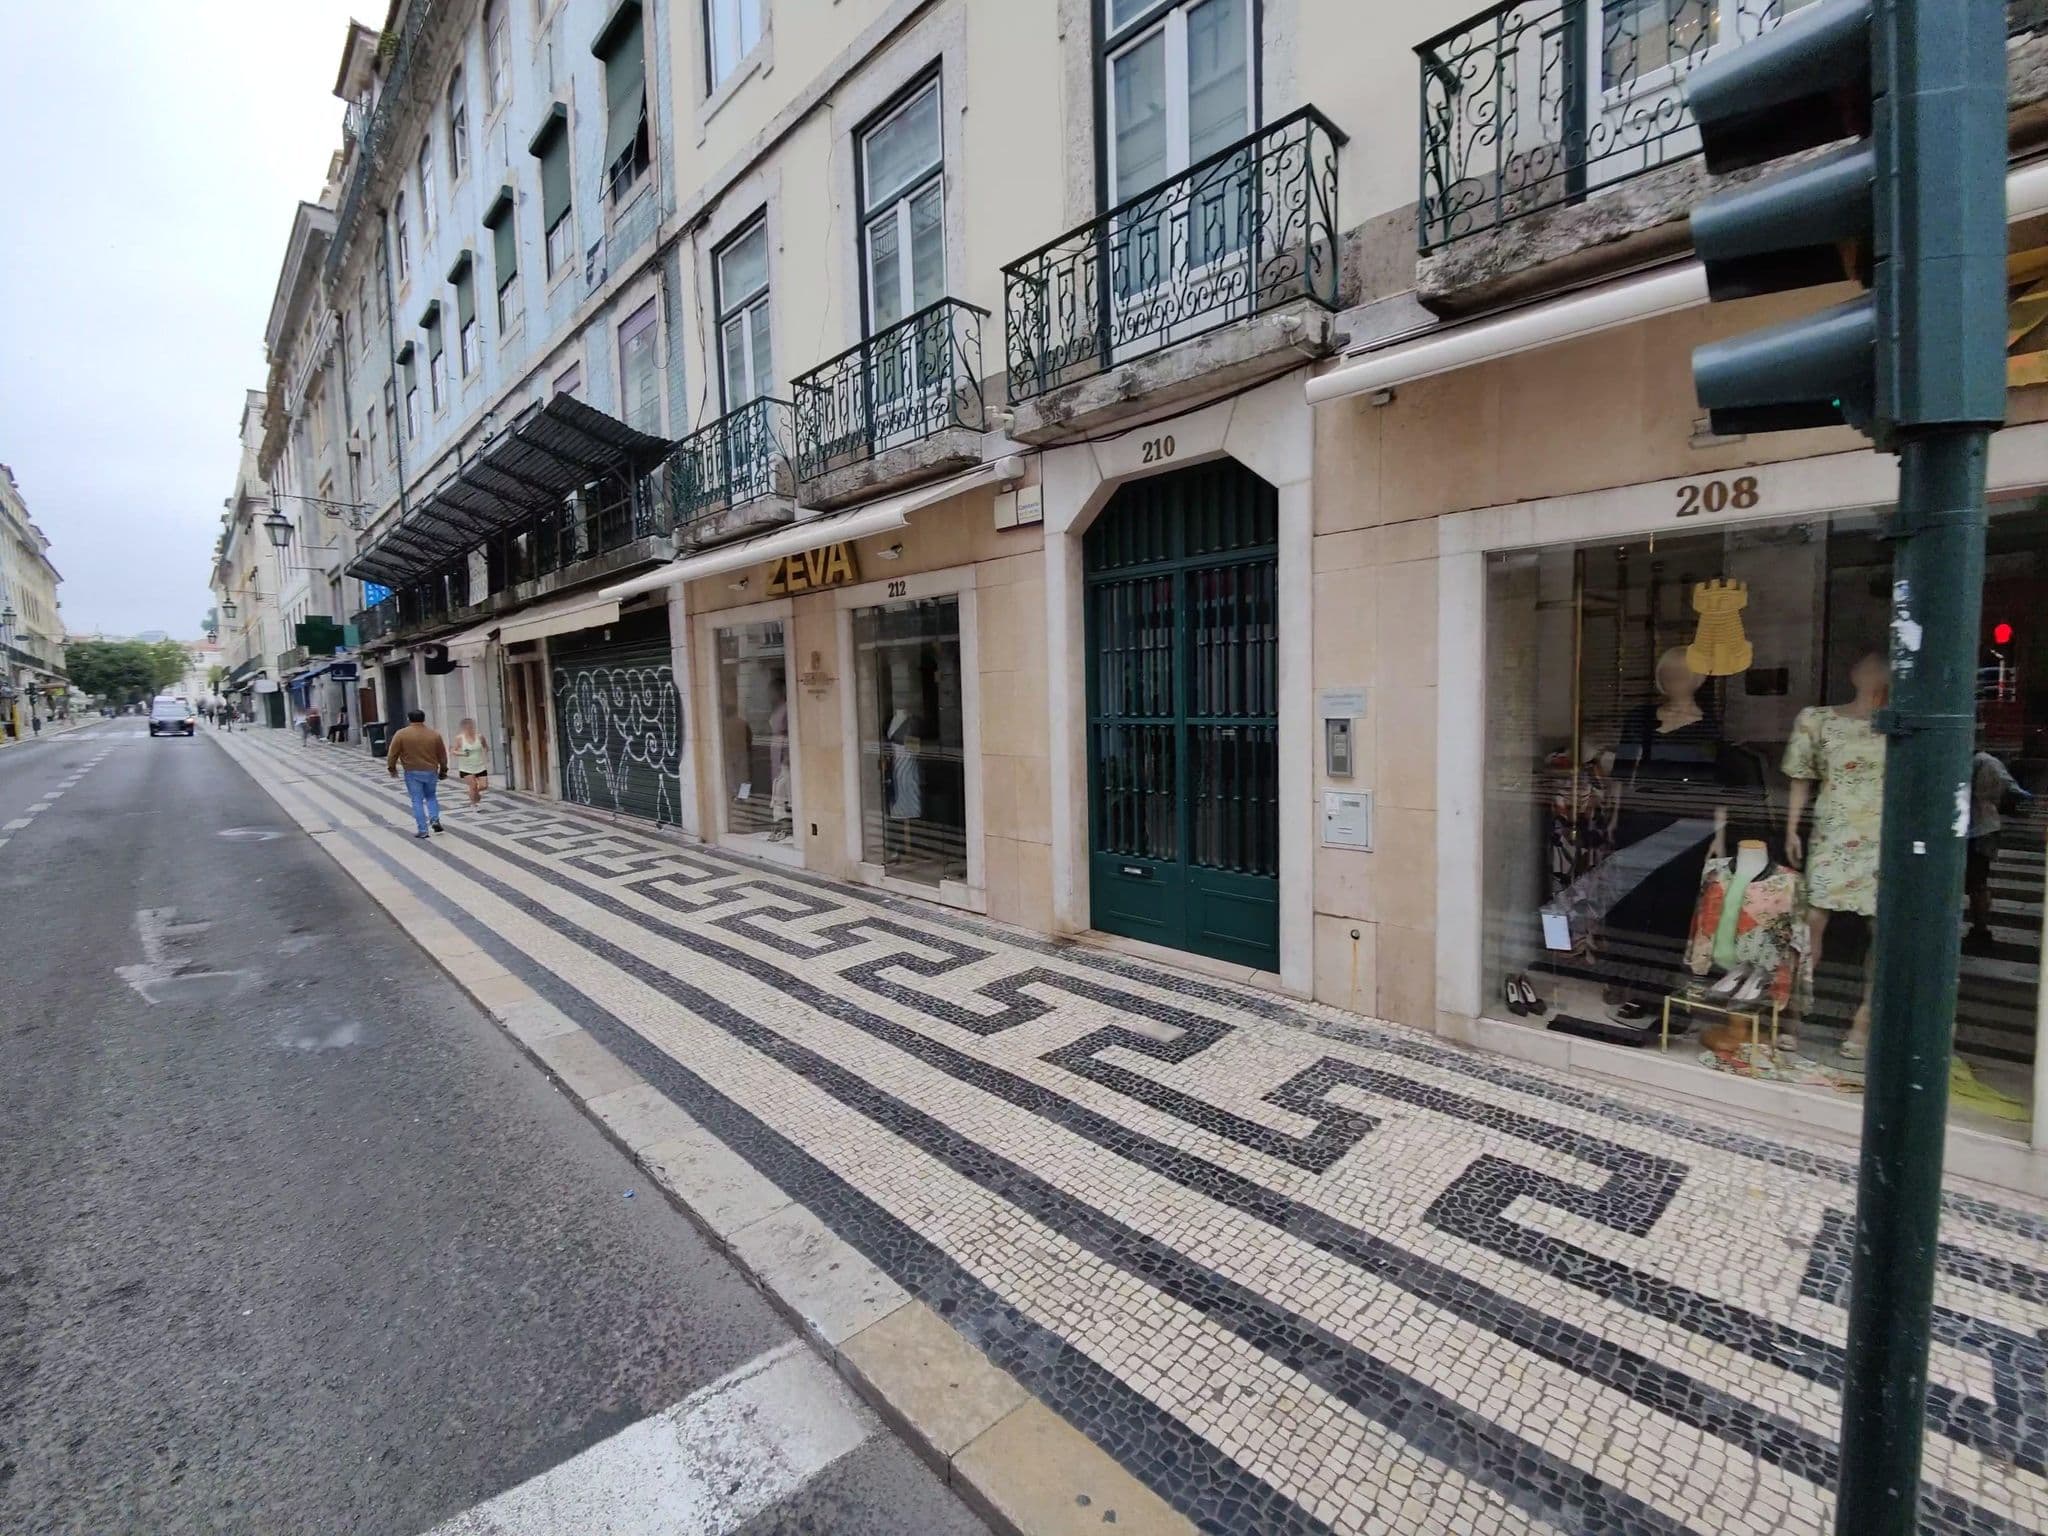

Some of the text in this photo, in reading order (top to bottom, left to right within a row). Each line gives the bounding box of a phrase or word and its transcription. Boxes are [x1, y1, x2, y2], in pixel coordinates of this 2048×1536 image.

[1142, 435, 1175, 464] 210
[1676, 476, 1759, 518] 208
[767, 541, 856, 594] ZEVA
[888, 580, 906, 598] 212
